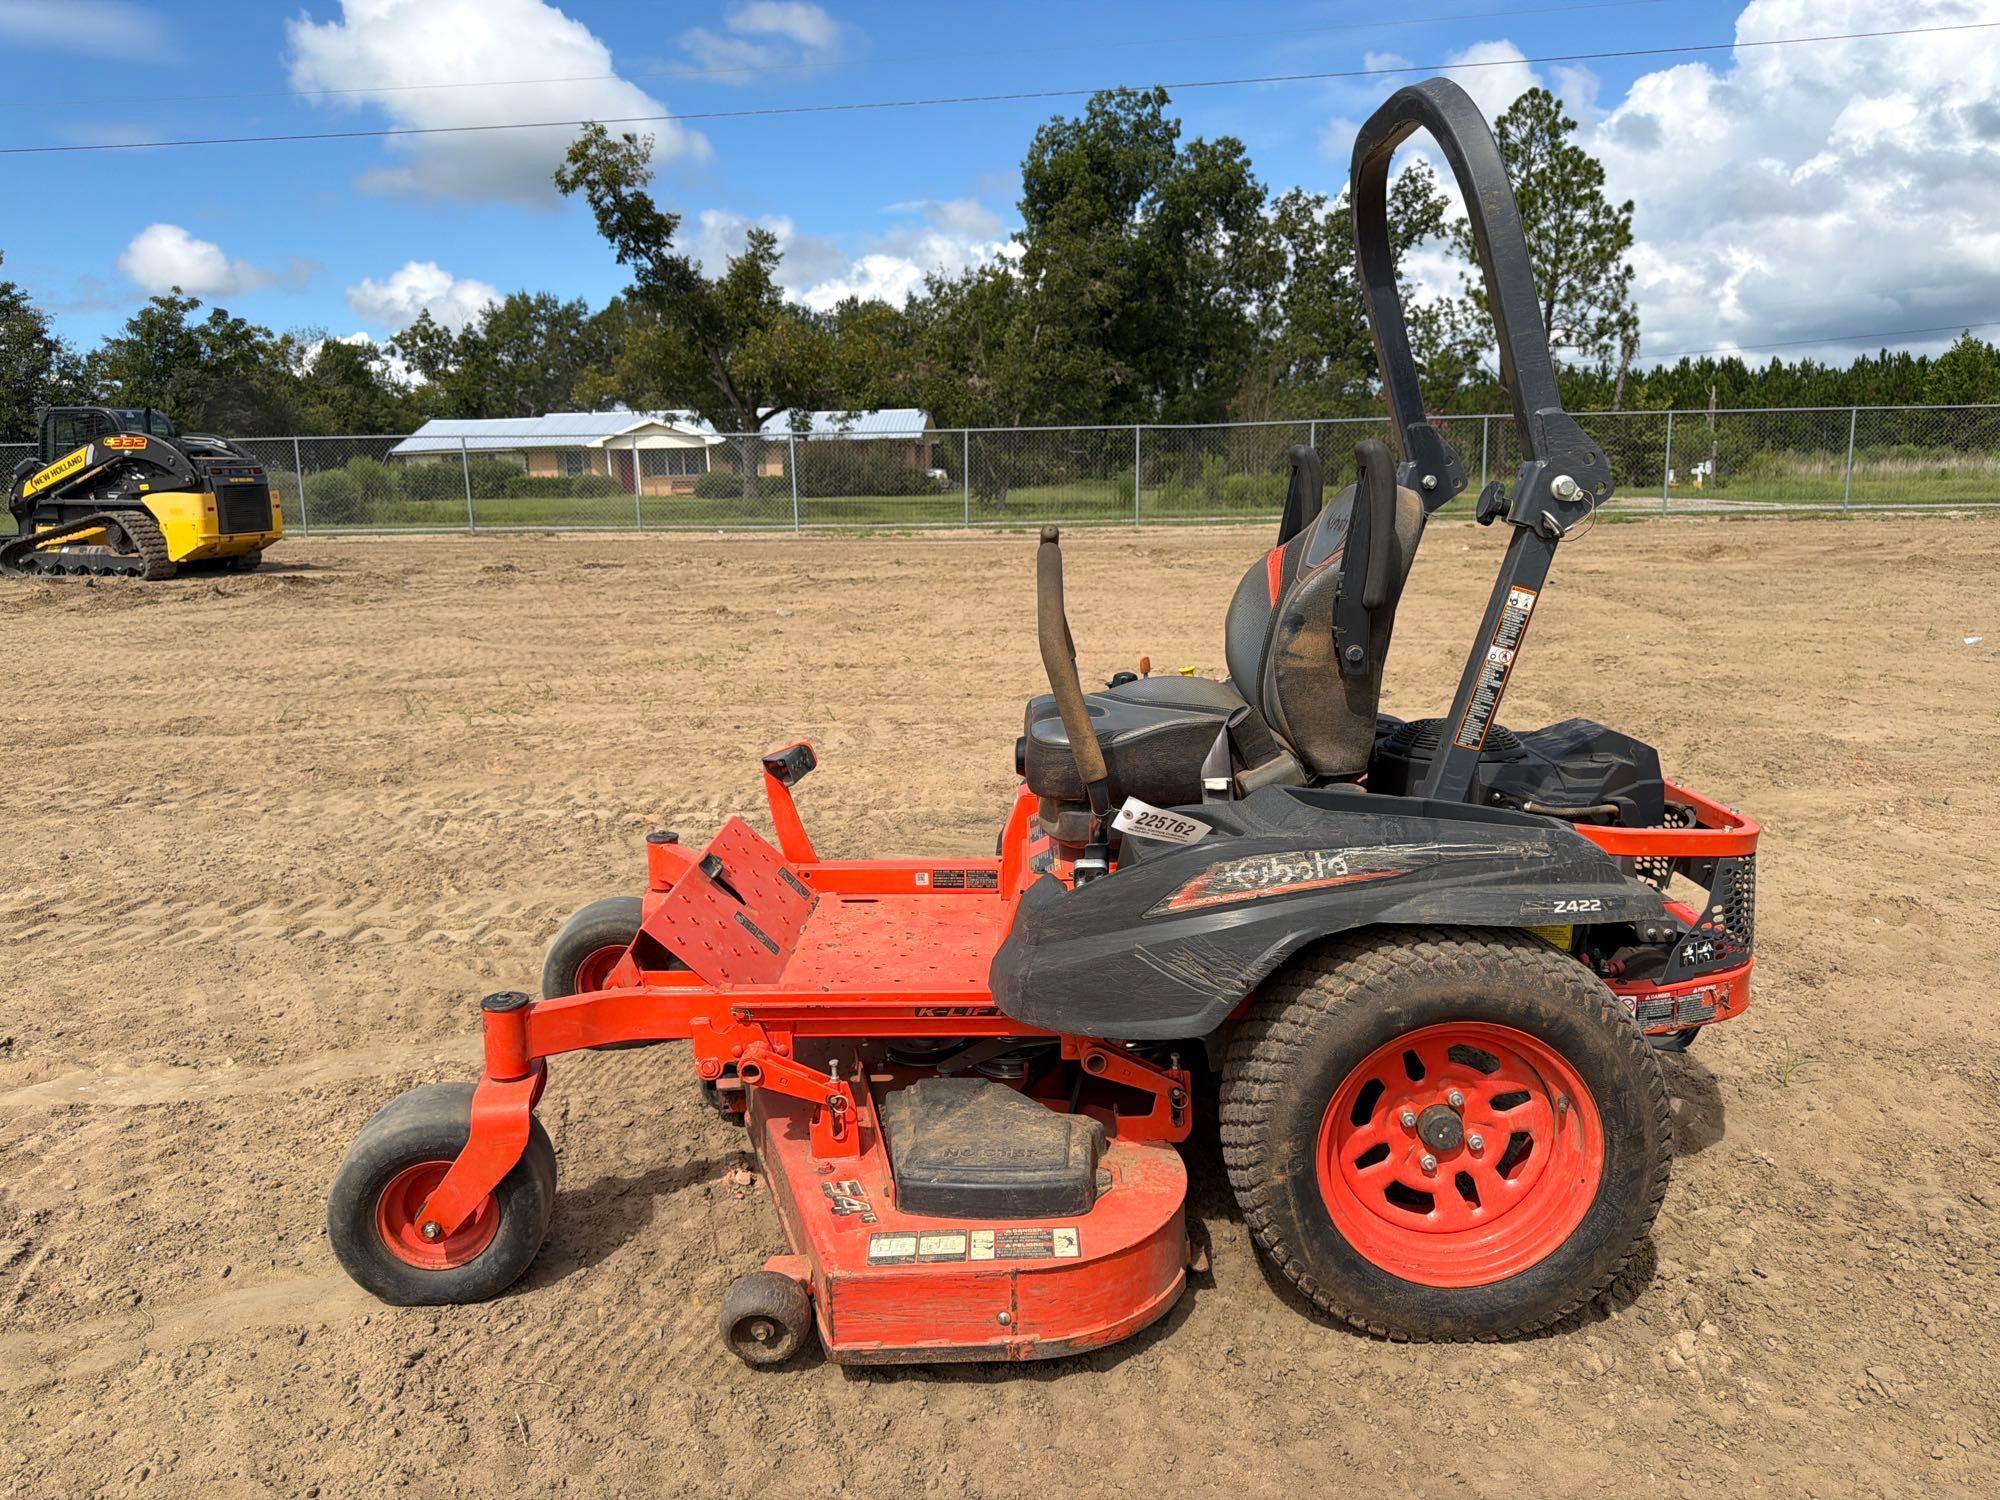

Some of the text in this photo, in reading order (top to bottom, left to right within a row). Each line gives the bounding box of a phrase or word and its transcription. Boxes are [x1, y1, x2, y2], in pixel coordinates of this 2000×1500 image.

[33, 455, 83, 486] NEW HOLLAND
[1135, 811, 1196, 836] 225762
[1224, 850, 1349, 885] Kubota
[1553, 899, 1602, 913] Z422
